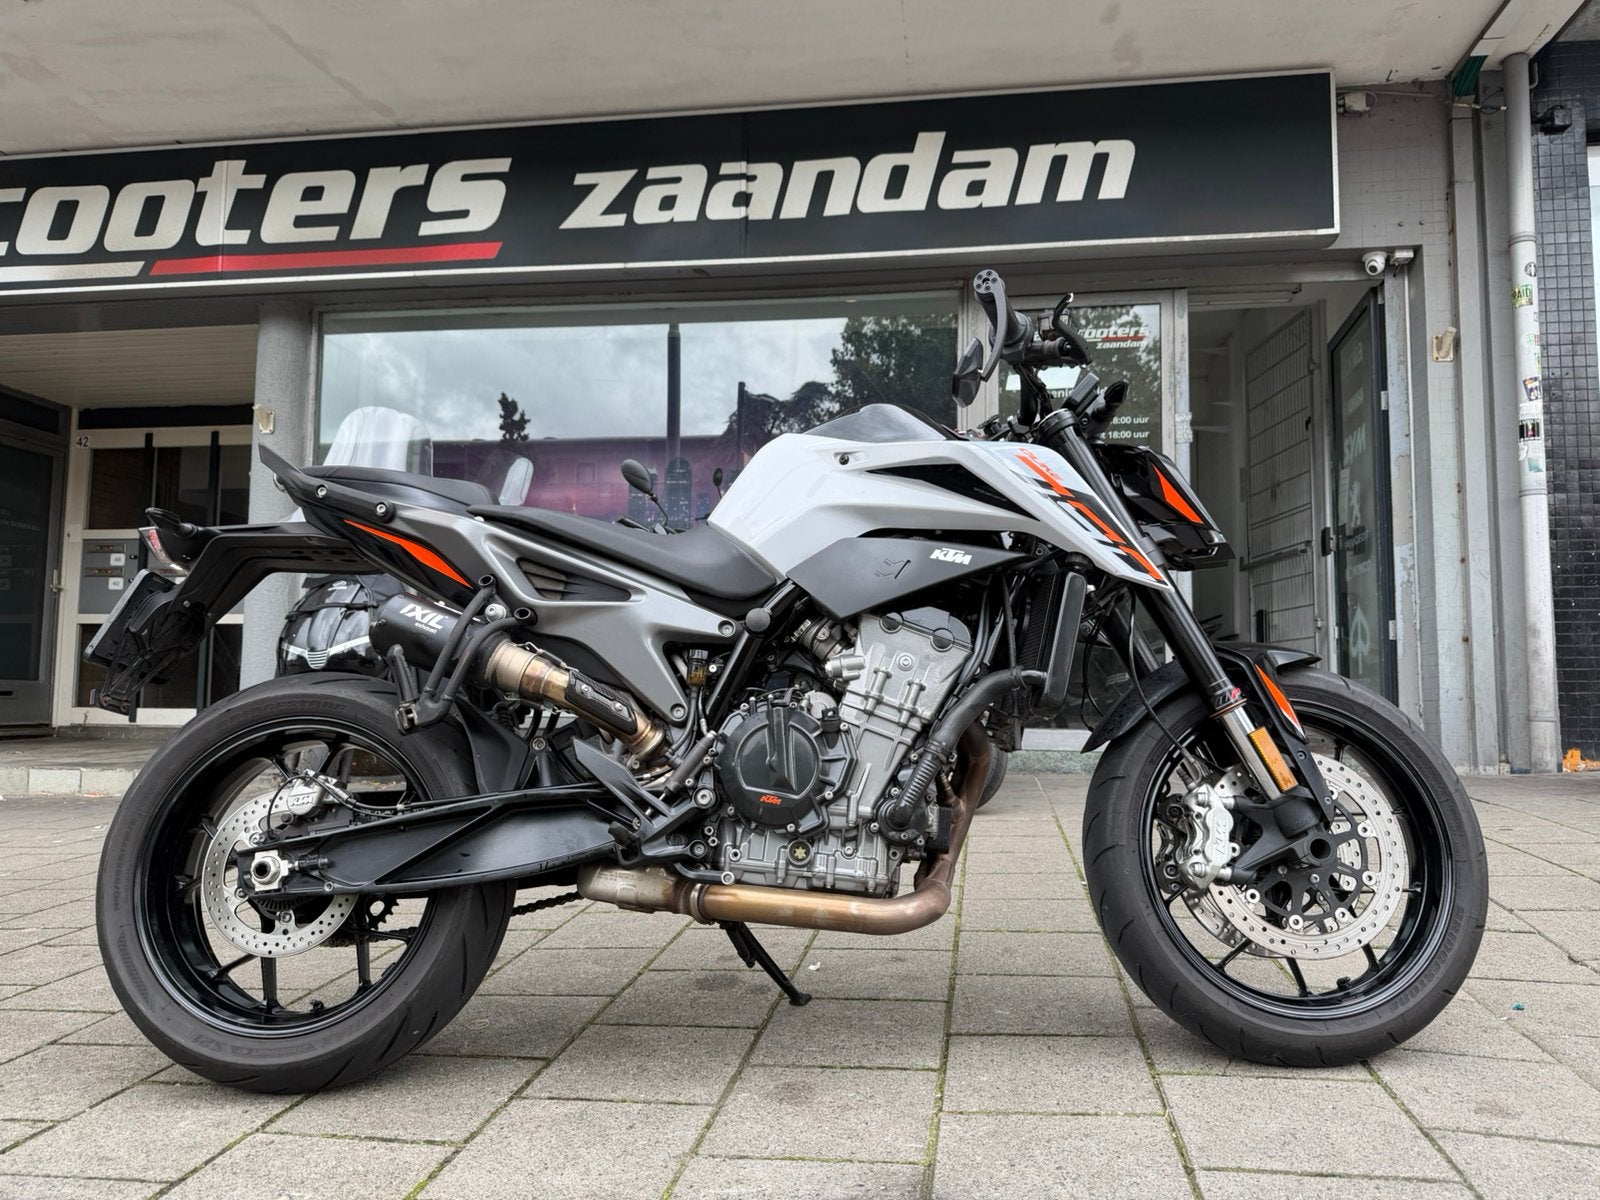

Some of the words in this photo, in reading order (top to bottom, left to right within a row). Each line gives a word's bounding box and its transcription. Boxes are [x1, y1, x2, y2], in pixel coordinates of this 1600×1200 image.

[0, 158, 511, 257] ooters
[559, 132, 1135, 229] zaandam
[1110, 416, 1132, 425] 8:00
[1133, 416, 1150, 425] uur
[1107, 430, 1132, 439] 18:00
[1133, 430, 1151, 439] uur
[76, 436, 89, 447] 42
[929, 547, 972, 565] KTM
[399, 604, 444, 630] IXIL
[759, 794, 781, 805] KTM
